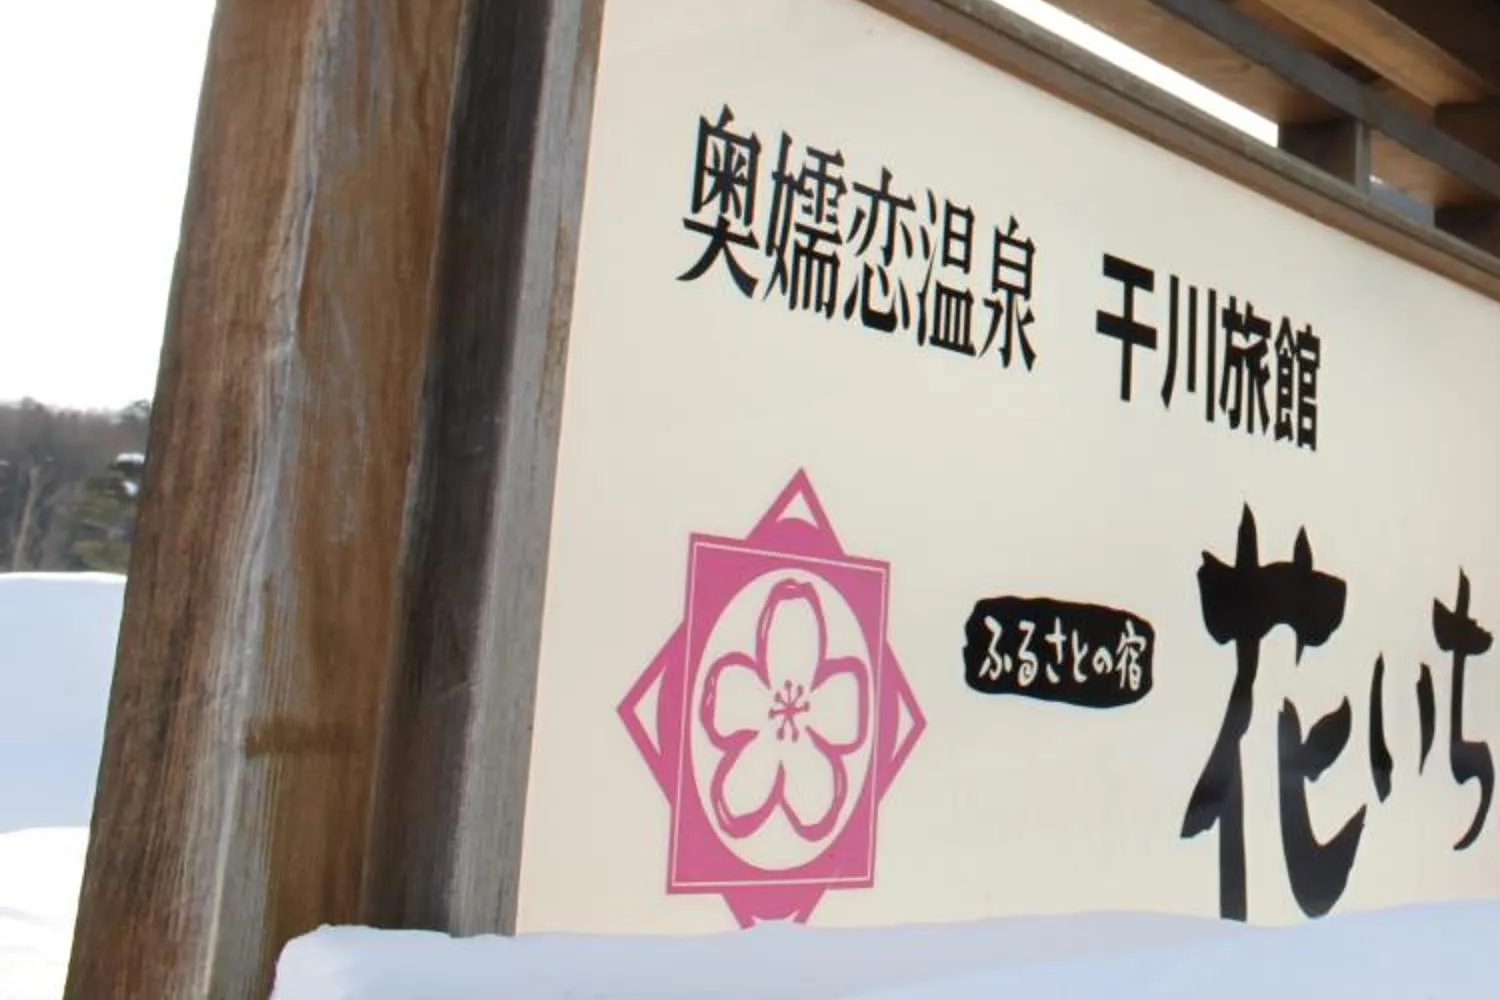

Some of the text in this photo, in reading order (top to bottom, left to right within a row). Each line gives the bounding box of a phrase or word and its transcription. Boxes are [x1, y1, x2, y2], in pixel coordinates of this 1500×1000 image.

[675, 103, 1320, 451] 奥嬬恋温泉 干川旅館
[978, 615, 1148, 691] ふるさとの宿
[1180, 499, 1494, 922] 花いち
